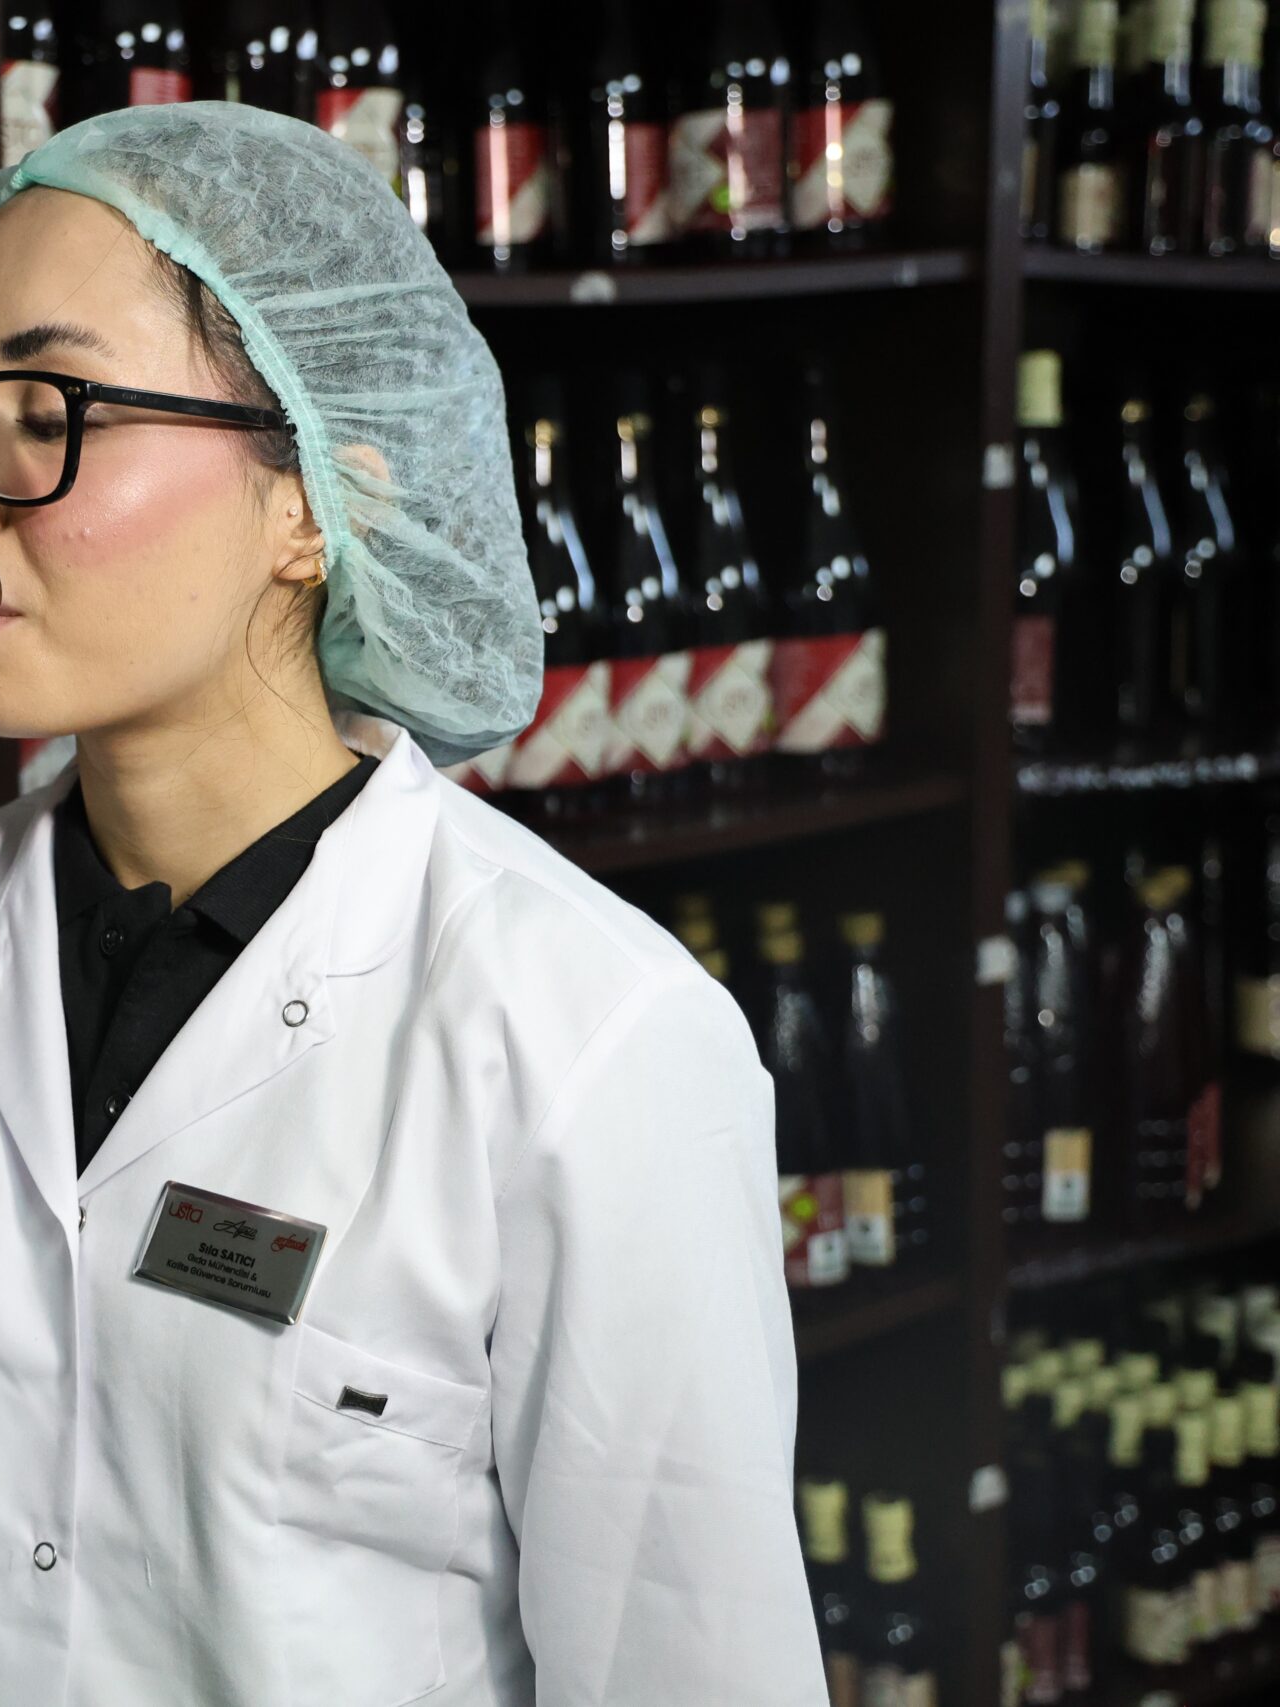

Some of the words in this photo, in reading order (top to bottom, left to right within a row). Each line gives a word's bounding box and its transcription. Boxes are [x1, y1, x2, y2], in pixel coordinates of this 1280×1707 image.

[219, 1248, 257, 1268] SATICI
[190, 1266, 227, 1285] Güvence
[228, 1278, 272, 1299] Sorumlusu
[250, 1272, 258, 1282] &
